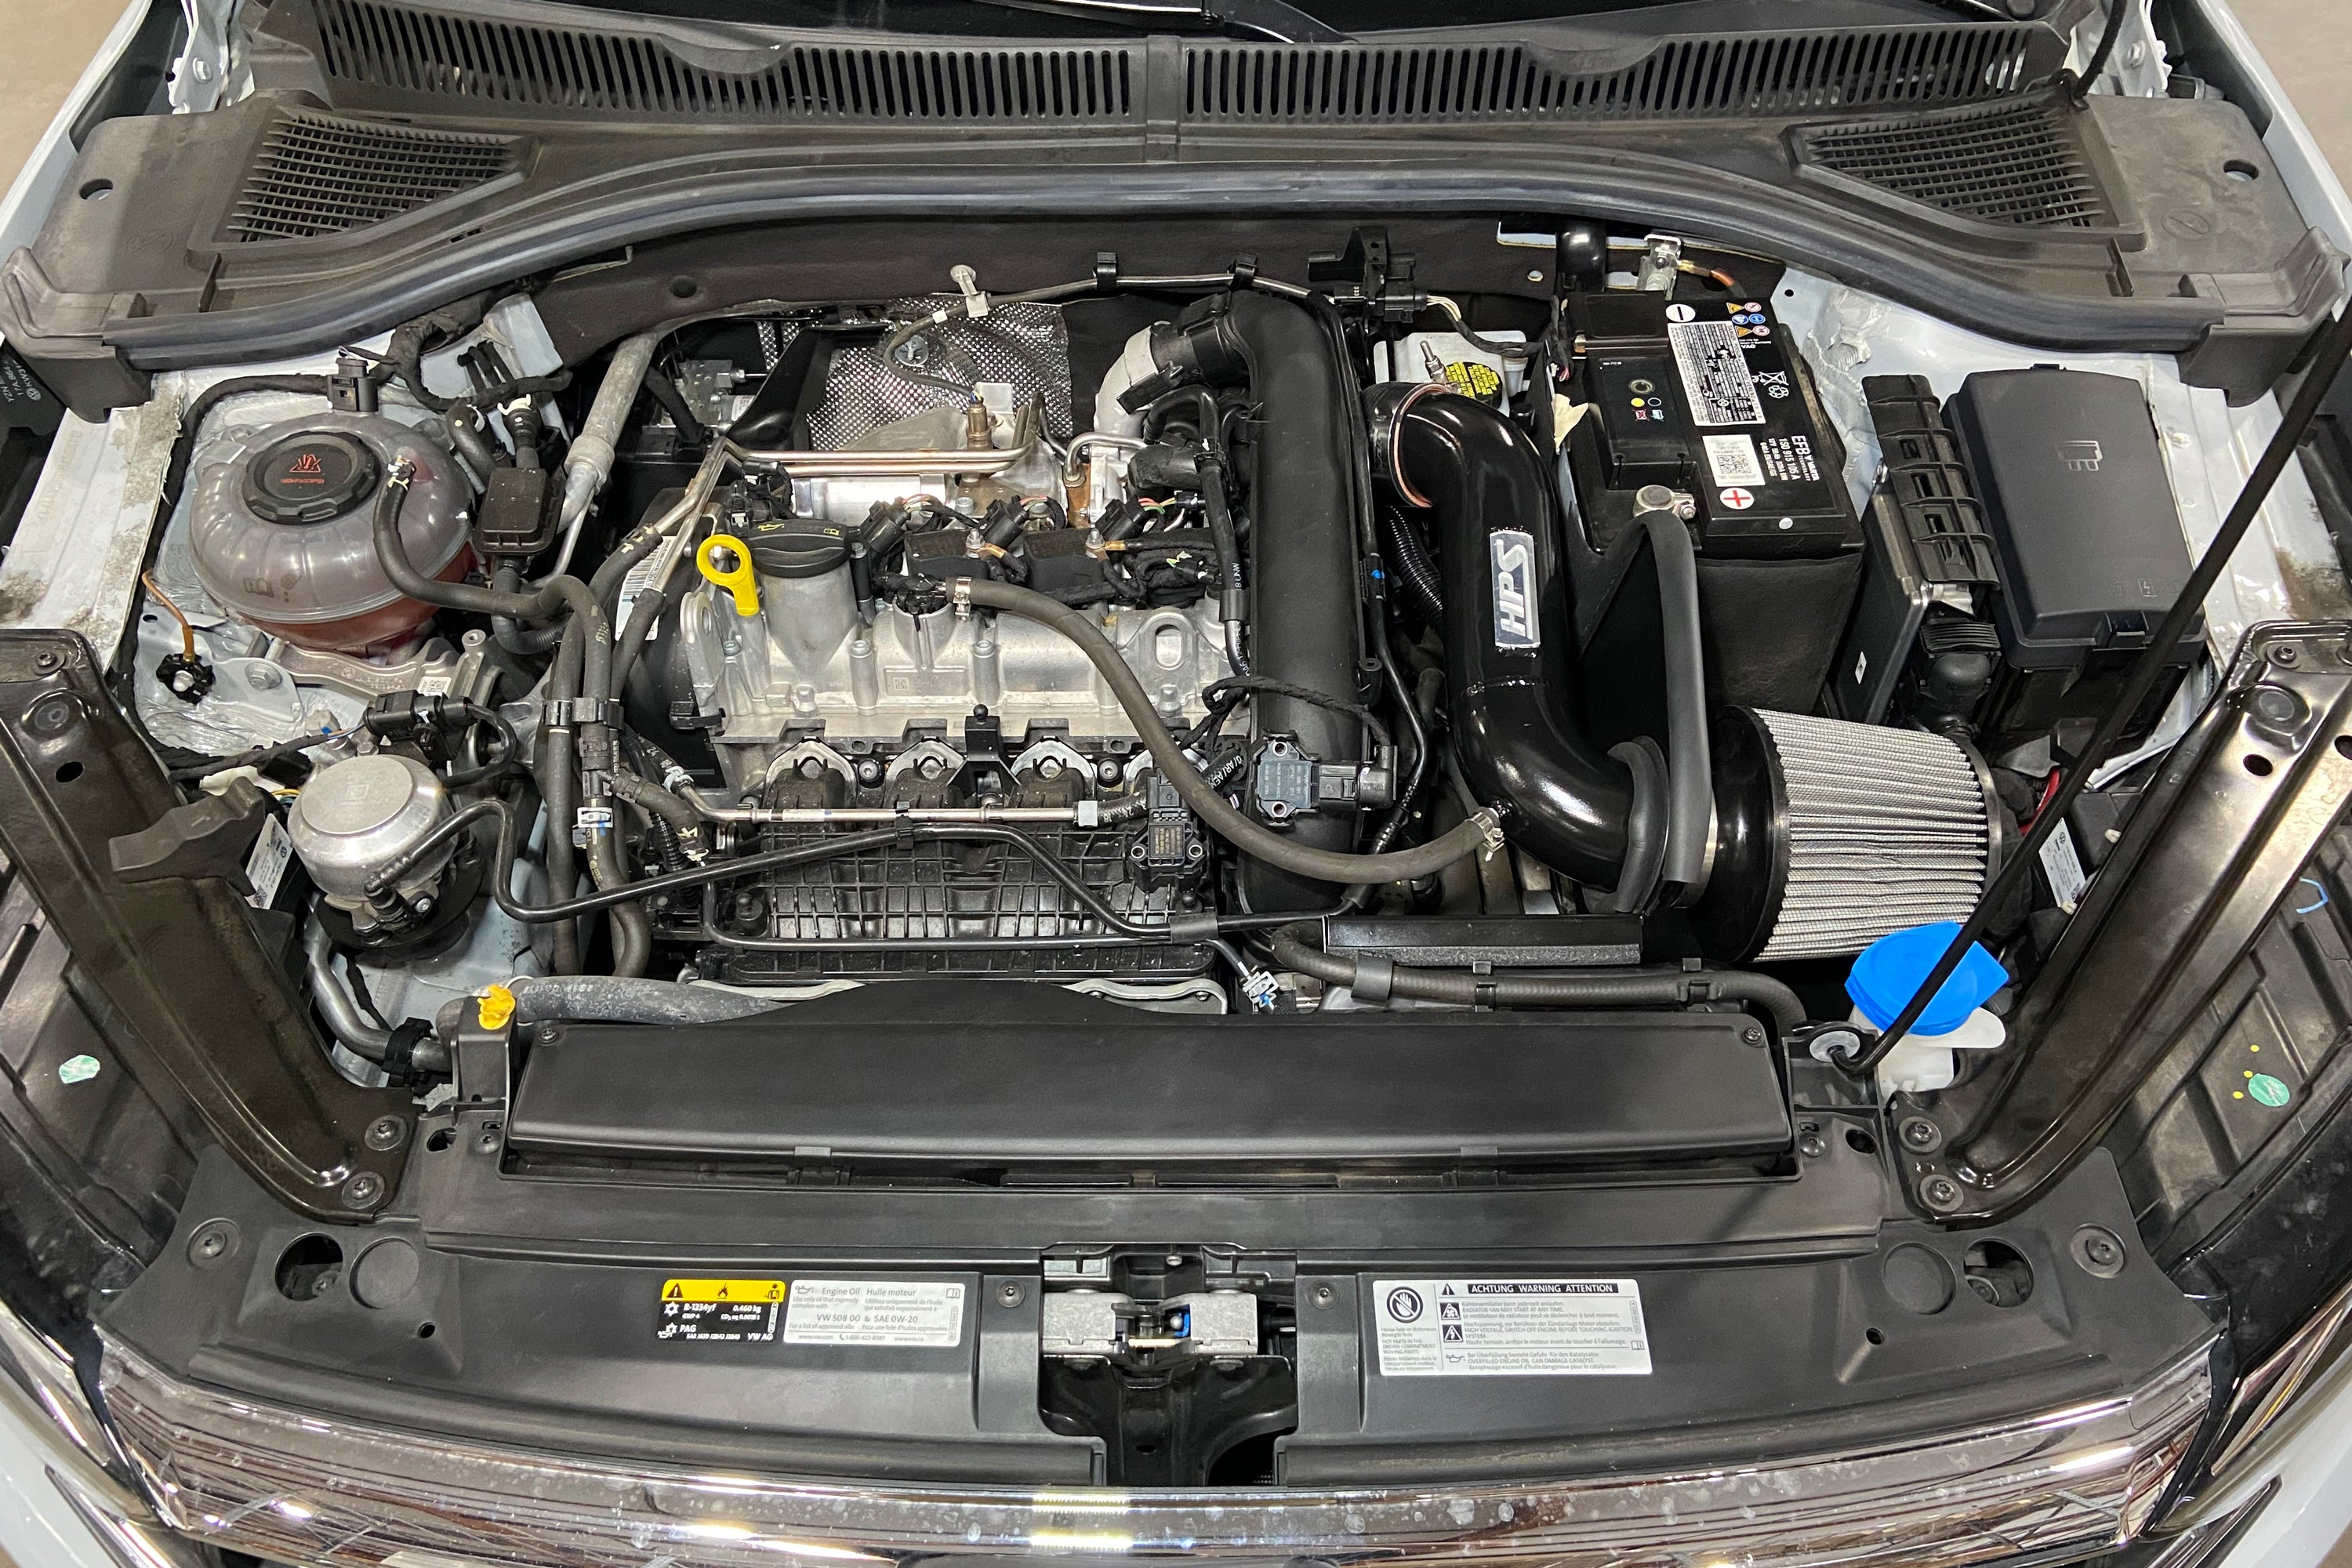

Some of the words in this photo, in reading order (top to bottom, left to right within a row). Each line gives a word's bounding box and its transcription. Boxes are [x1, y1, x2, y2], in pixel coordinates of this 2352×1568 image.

[1791, 436, 1810, 454] EFB
[1783, 451, 1794, 461] 915
[1787, 463, 1798, 474] 105
[1496, 539, 1534, 641] HPS
[822, 1287, 848, 1296] Engine
[1472, 1284, 1514, 1293] ACHTUNG
[1518, 1284, 1562, 1293] WARNING
[1565, 1284, 1613, 1293] ATTENTION
[753, 1305, 762, 1313] kg
[680, 1324, 697, 1333] PAG
